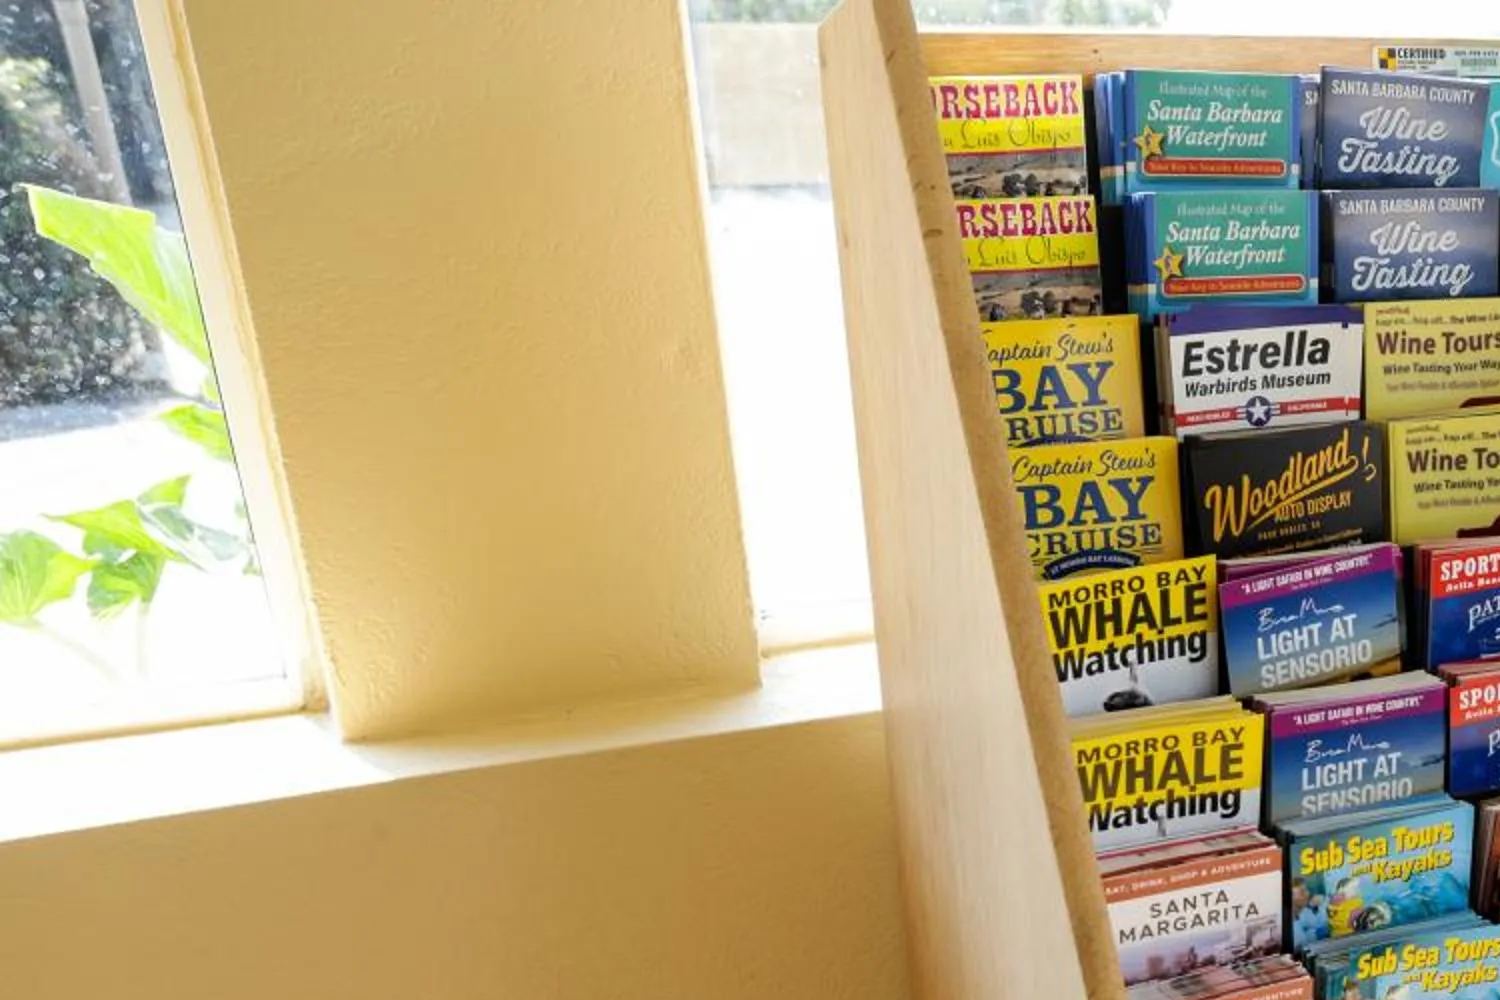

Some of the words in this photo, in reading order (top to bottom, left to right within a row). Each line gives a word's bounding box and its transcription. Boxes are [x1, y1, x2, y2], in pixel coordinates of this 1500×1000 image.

[931, 80, 1079, 120] RSEBACK
[1148, 100, 1205, 121] Santa
[1207, 100, 1283, 123] Barbara
[1166, 125, 1267, 151] Waterfront
[1360, 106, 1449, 142] Wine
[1338, 138, 1460, 187] Tasting
[1166, 222, 1223, 243] Santa
[1226, 218, 1300, 241] Barbara
[1370, 221, 1460, 256] Wine
[1185, 243, 1285, 268] Waterfront
[1352, 256, 1474, 296] Tasting
[1182, 330, 1331, 378] Estrella
[1376, 331, 1436, 355] Wine
[1185, 376, 1257, 398] Warbirds
[1260, 371, 1331, 389] Museum
[1383, 363, 1410, 375] Wine
[1413, 362, 1452, 378] Tasting
[1454, 360, 1478, 374] Your
[1407, 448, 1467, 474] Wine
[1017, 476, 1154, 531] BAY
[1205, 428, 1360, 543] Woodland
[1048, 574, 1145, 610] MORRO
[1157, 564, 1208, 588] BAY
[1048, 582, 1209, 650] WHALE
[1052, 628, 1208, 684] Watching
[1257, 624, 1323, 661] LIGHT
[1330, 614, 1358, 639] AT
[1260, 640, 1373, 689] SENSORIO
[1076, 735, 1180, 765] MORRO
[1191, 726, 1246, 747] BAY
[1077, 741, 1244, 803] WHALE
[1302, 761, 1369, 790] LIGHT
[1375, 752, 1402, 777] AT
[1088, 787, 1241, 833] Watching
[1301, 843, 1343, 876] Sub
[1348, 832, 1388, 863] Sea
[1392, 821, 1454, 853] Tours
[1119, 902, 1260, 945] MARGARITA
[1150, 889, 1230, 918] SANTA
[1357, 954, 1397, 980] Sub
[1403, 944, 1441, 972] Sea
